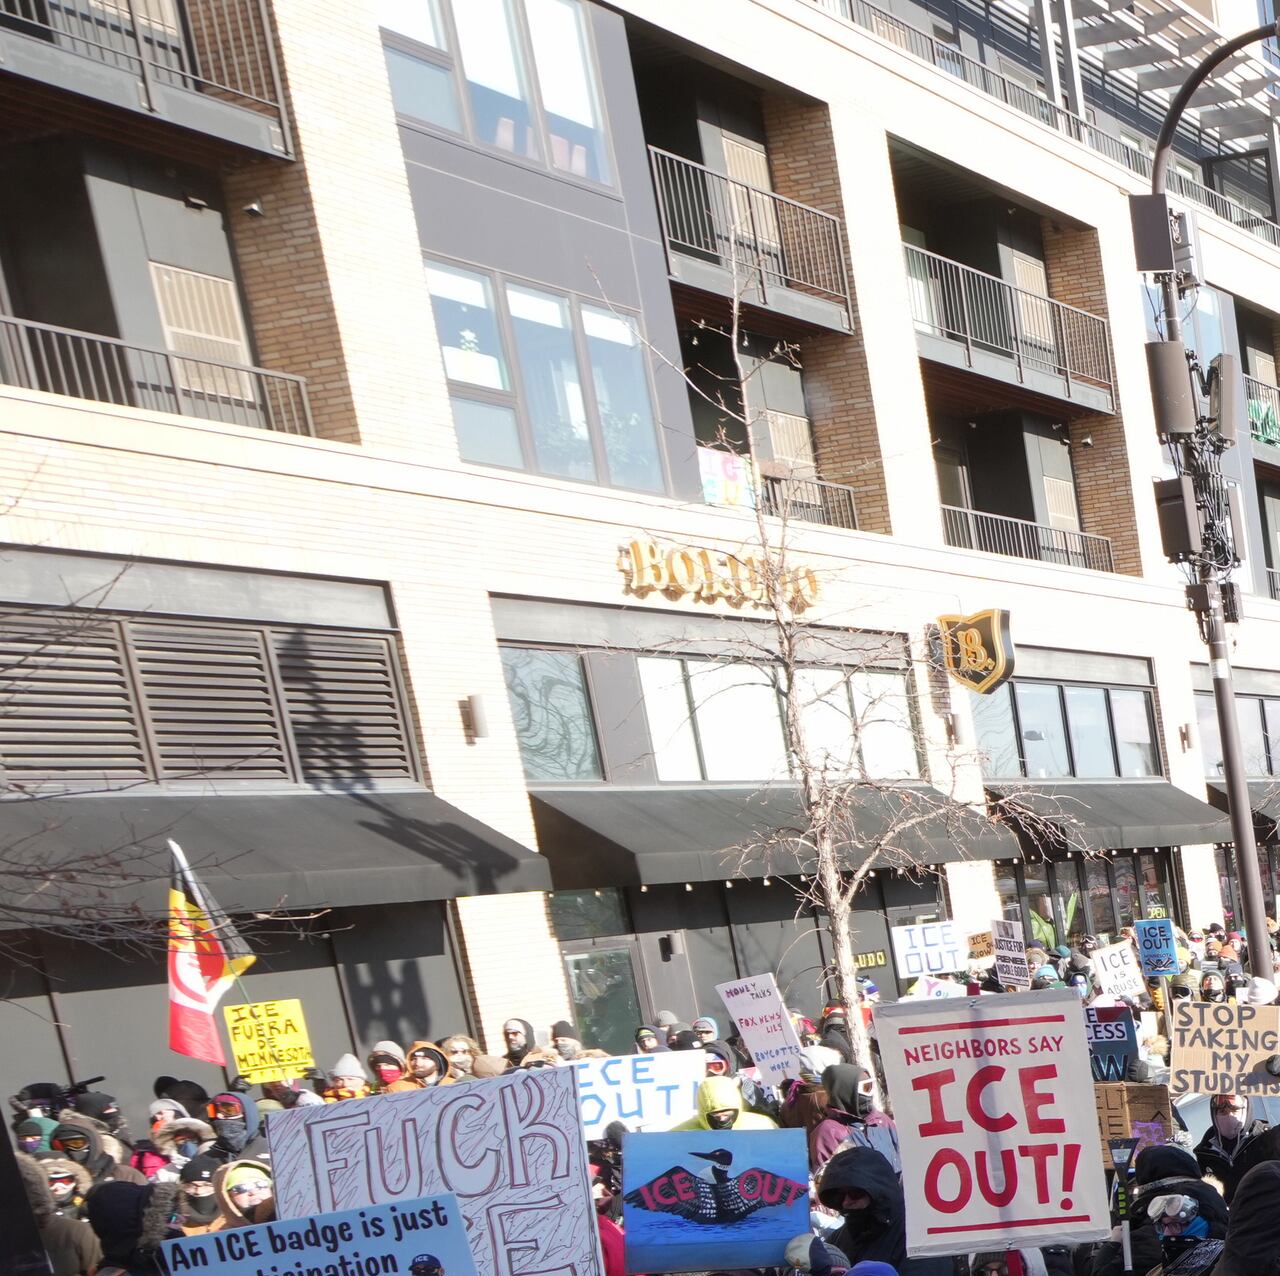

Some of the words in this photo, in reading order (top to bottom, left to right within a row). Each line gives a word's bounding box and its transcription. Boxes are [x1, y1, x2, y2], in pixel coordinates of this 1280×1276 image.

[1142, 938, 1170, 950] OUT
[904, 950, 959, 975] OUT
[750, 989, 772, 1000] TALKS
[1107, 977, 1140, 995] ABUSE
[738, 1017, 758, 1028] FOX
[759, 1012, 781, 1024] NEWS
[1177, 1002, 1256, 1028] STOP
[258, 1037, 277, 1050] DE
[904, 1037, 1023, 1066] NEIGHBORS
[1029, 1035, 1064, 1053] SAY
[1175, 1028, 1278, 1050] TAKING
[1212, 1052, 1250, 1072] MY
[911, 1064, 1066, 1138] ICE
[303, 1075, 571, 1213] FUCK
[739, 1167, 807, 1208] OUT
[924, 1144, 1080, 1213] OUT!
[172, 1242, 208, 1271] An
[215, 1230, 261, 1262] ICE
[267, 1218, 353, 1252] badge
[360, 1211, 385, 1238] is
[390, 1200, 448, 1241] just
